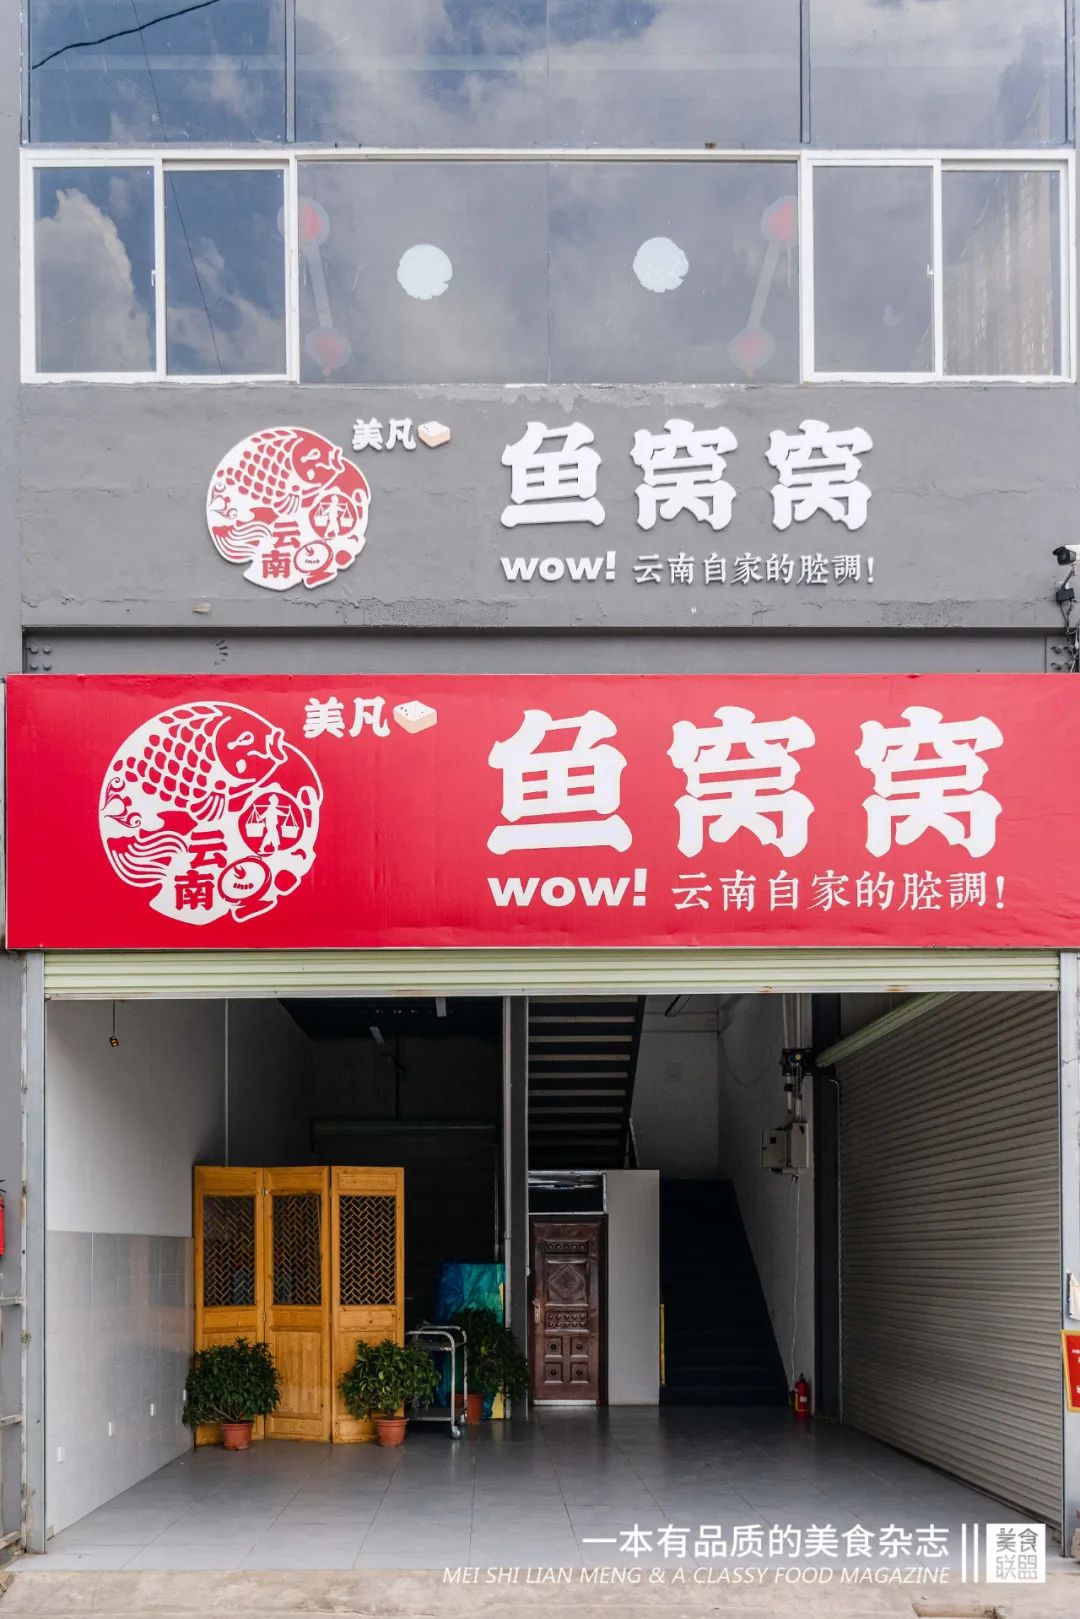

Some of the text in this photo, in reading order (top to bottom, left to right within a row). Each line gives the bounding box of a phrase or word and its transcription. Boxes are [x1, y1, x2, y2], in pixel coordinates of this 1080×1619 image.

[351, 417, 416, 451] 美凡
[500, 417, 873, 531] 鱼窝窝
[262, 521, 301, 579] 云南
[500, 550, 617, 582] wow!
[303, 695, 390, 739] 美凡
[486, 705, 1004, 858] 鱼窝窝
[174, 829, 228, 911] 云南
[487, 868, 648, 908] wow!
